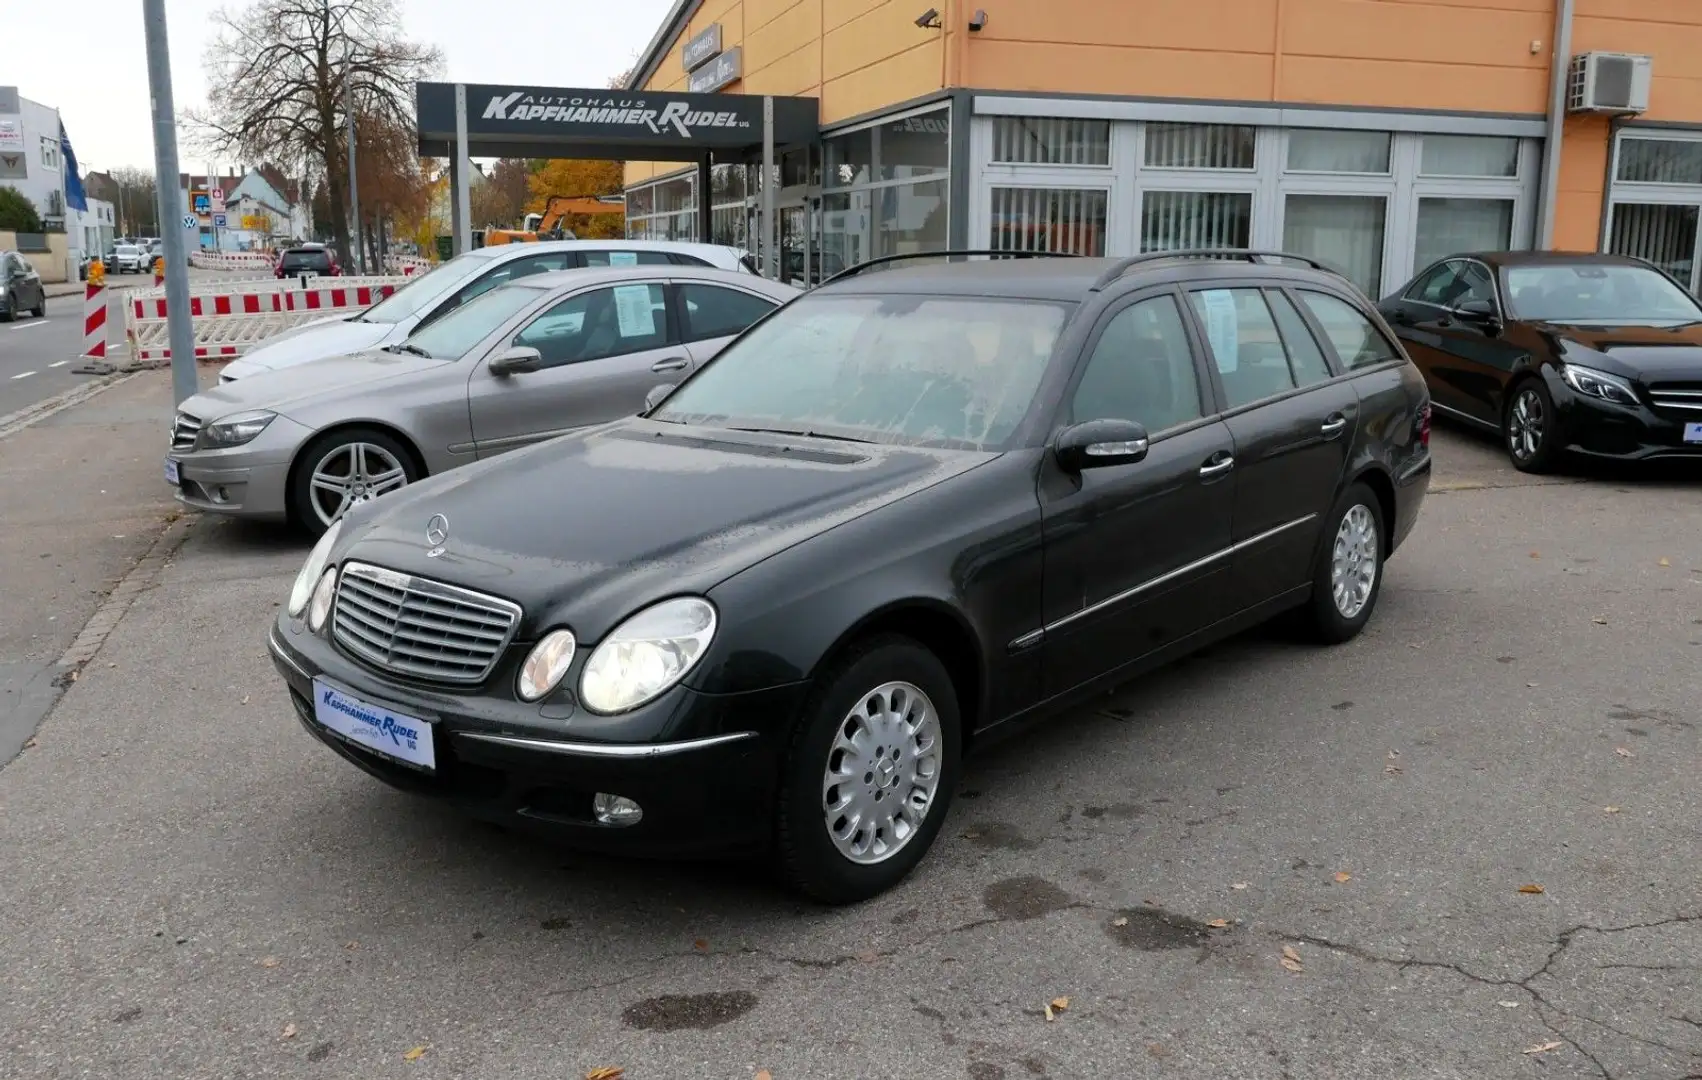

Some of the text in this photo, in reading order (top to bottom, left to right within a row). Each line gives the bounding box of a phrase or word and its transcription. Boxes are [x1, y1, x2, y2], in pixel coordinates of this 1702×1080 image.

[482, 92, 659, 134] KAPFHAMMER
[658, 101, 739, 138] RUDEL
[522, 95, 646, 109] AUTOHAUS
[323, 691, 384, 736] KAPFHAMMER
[383, 715, 418, 746] RUDEL
